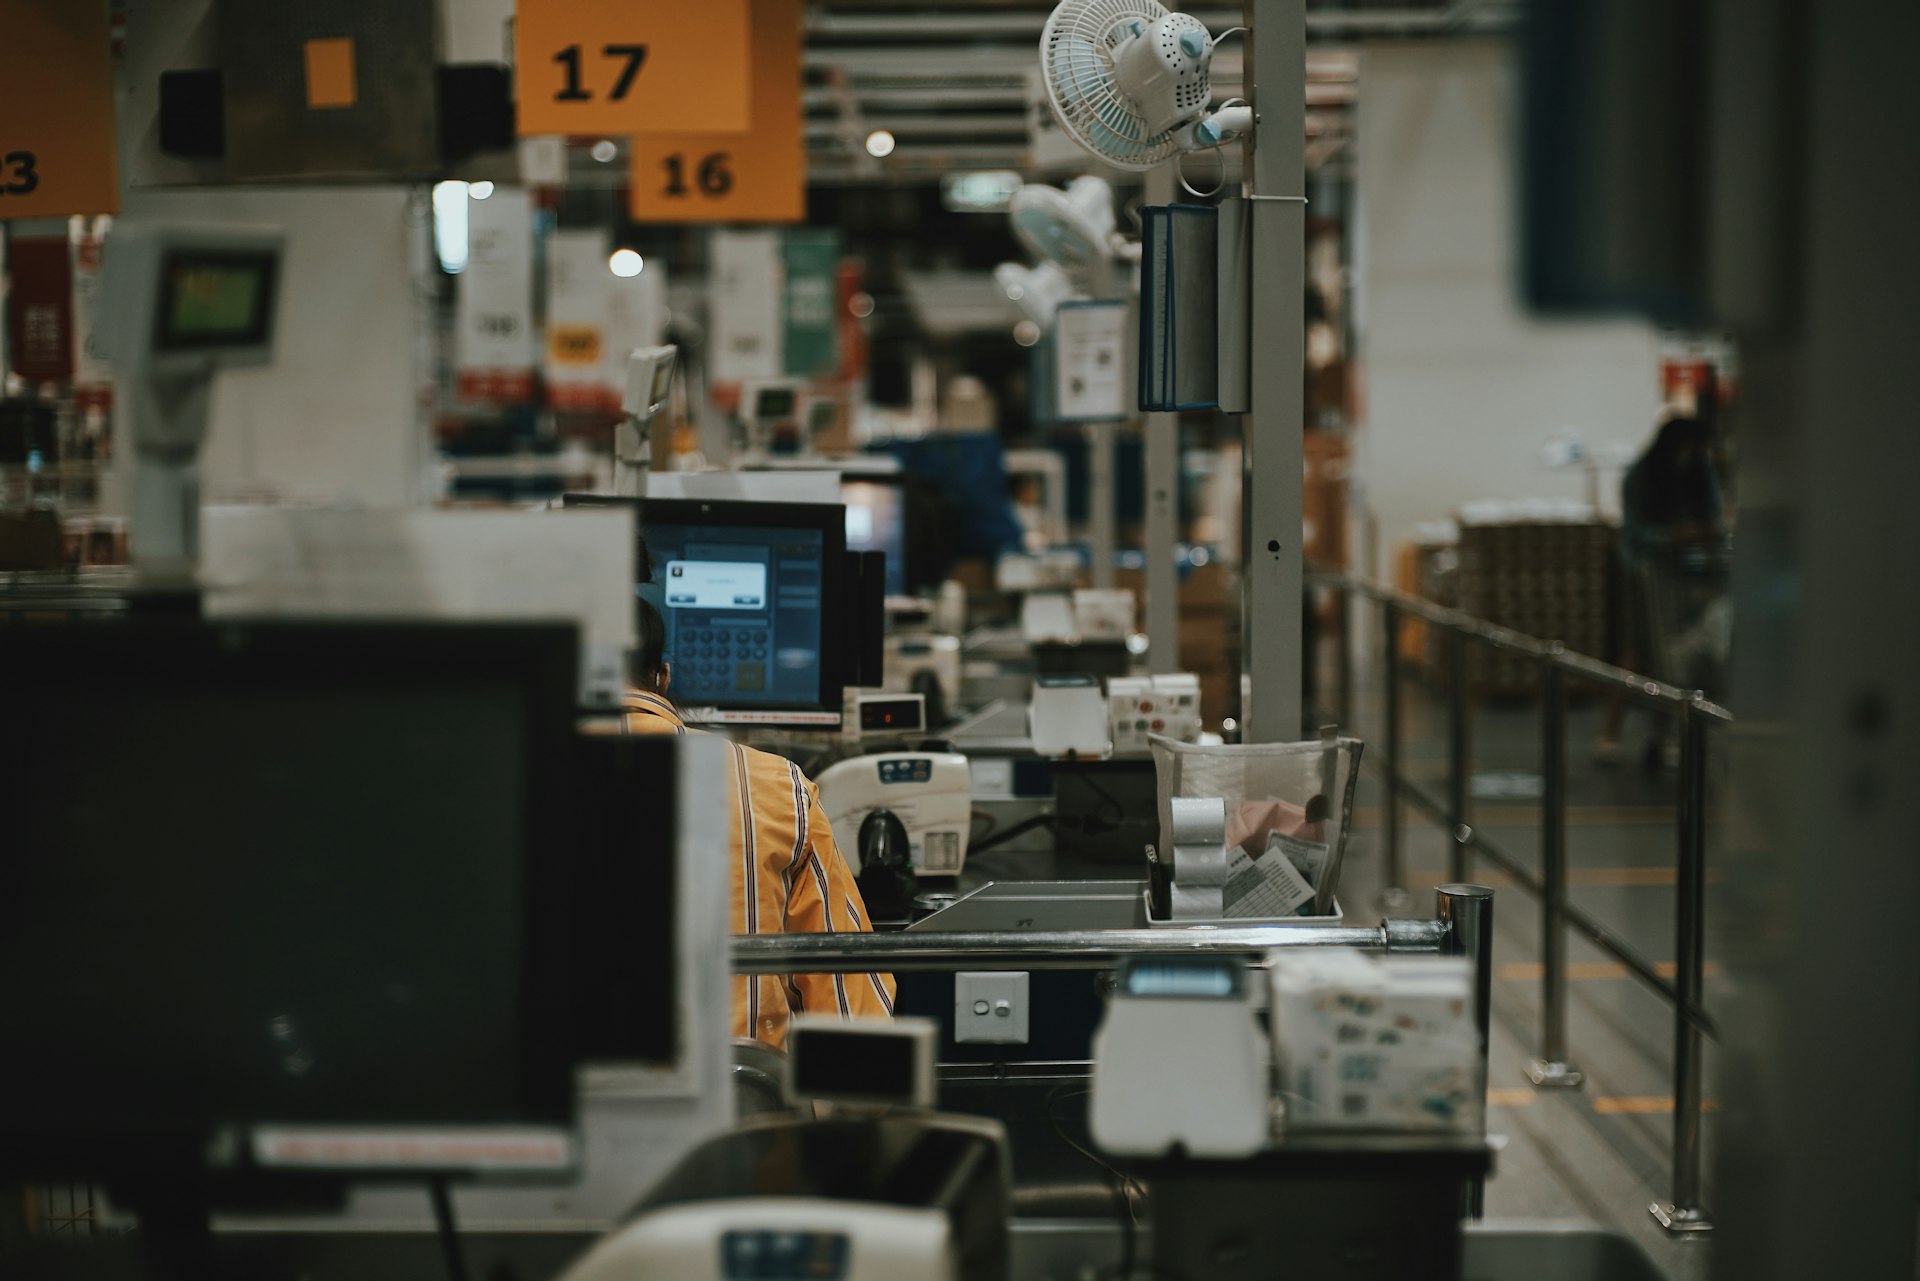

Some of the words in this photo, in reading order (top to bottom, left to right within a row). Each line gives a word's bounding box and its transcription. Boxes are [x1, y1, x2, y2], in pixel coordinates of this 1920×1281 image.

[553, 44, 649, 102] 17
[0, 151, 39, 196] 3
[661, 152, 734, 198] 16
